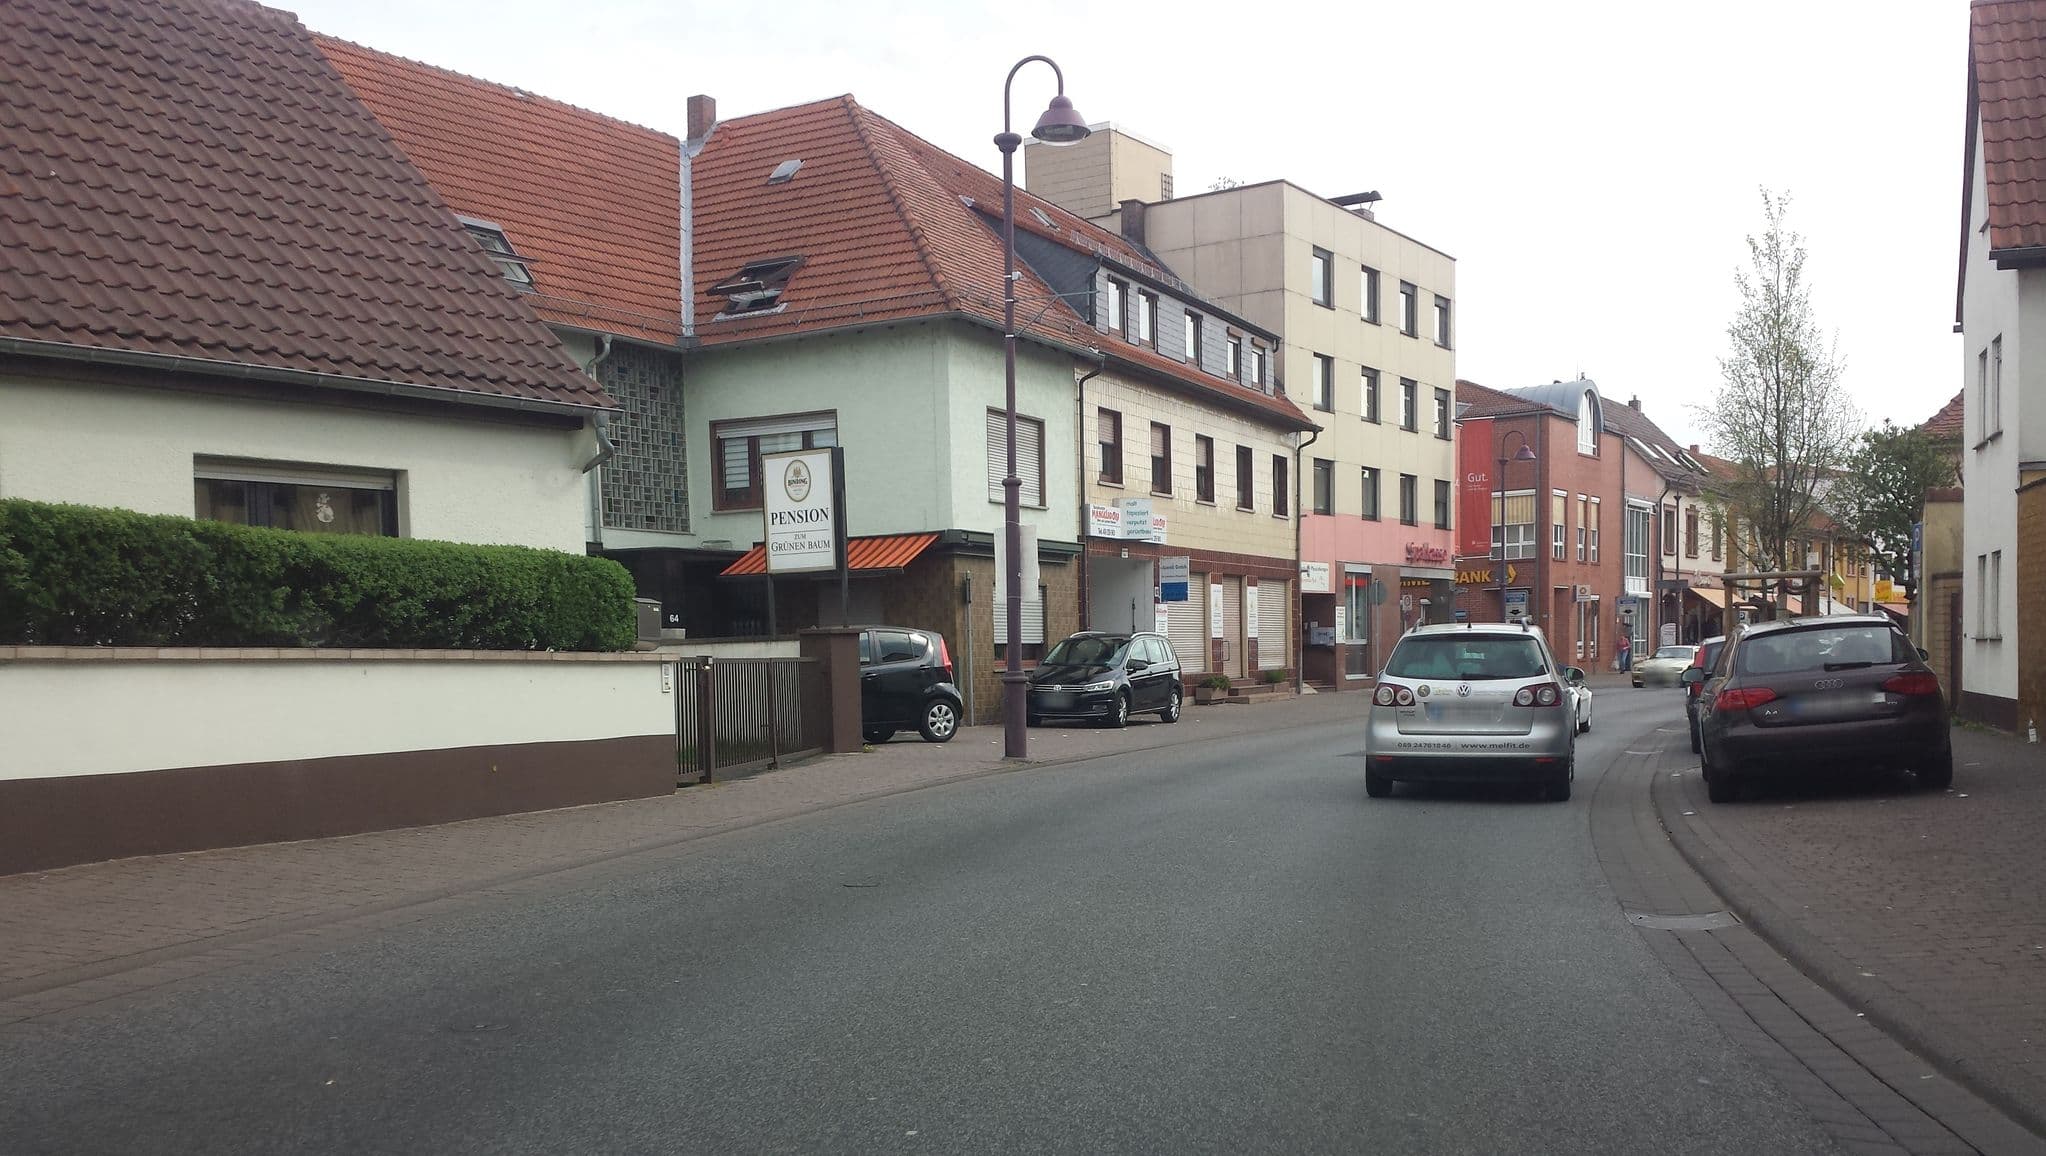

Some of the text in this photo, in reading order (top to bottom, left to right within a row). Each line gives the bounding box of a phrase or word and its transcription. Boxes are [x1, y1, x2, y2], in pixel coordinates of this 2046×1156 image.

[1467, 472, 1488, 482] Gut.
[770, 507, 829, 526] PENSION
[771, 539, 831, 552] GRÜNEN BAUM
[669, 614, 679, 623] 64
